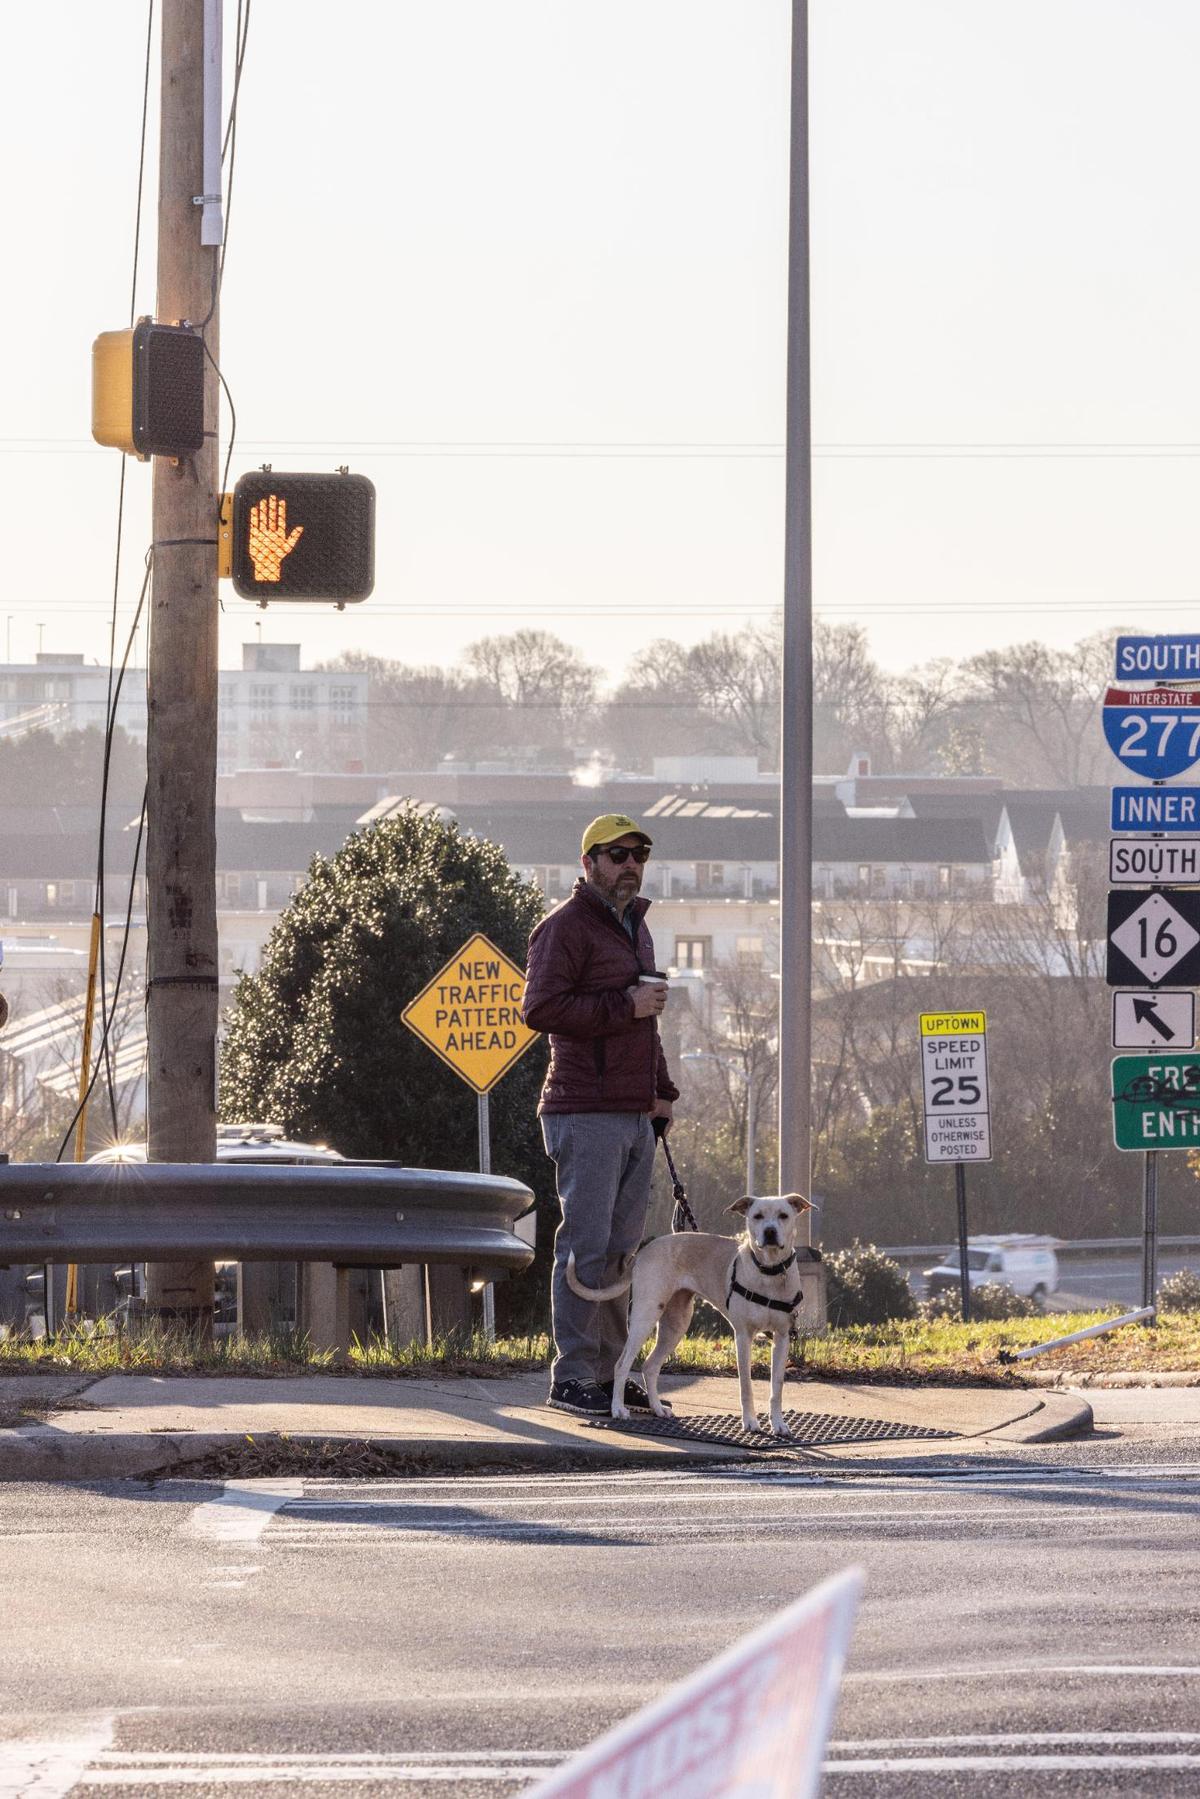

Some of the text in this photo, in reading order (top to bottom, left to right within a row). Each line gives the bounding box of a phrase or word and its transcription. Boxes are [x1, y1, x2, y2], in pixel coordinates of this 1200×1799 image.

[1121, 644, 1200, 671] SOUTH
[1129, 693, 1193, 705] INTERSTATE
[1119, 715, 1200, 757] 277
[1120, 796, 1196, 822] INNER
[1115, 848, 1196, 874] SOUTH
[1138, 917, 1177, 958] 16
[459, 961, 500, 981] NEW
[437, 983, 521, 1005] TRAFFIC
[436, 1007, 525, 1028] PATTERN
[926, 1018, 979, 1031] UPTOWN
[445, 1030, 516, 1051] AHEAD
[927, 1040, 980, 1054] SPEED
[935, 1057, 975, 1070] LIMIT
[931, 1076, 981, 1106] 25
[938, 1118, 977, 1129] UNLESS
[931, 1131, 985, 1142] OTHERWISE
[940, 1145, 977, 1155] POSTED
